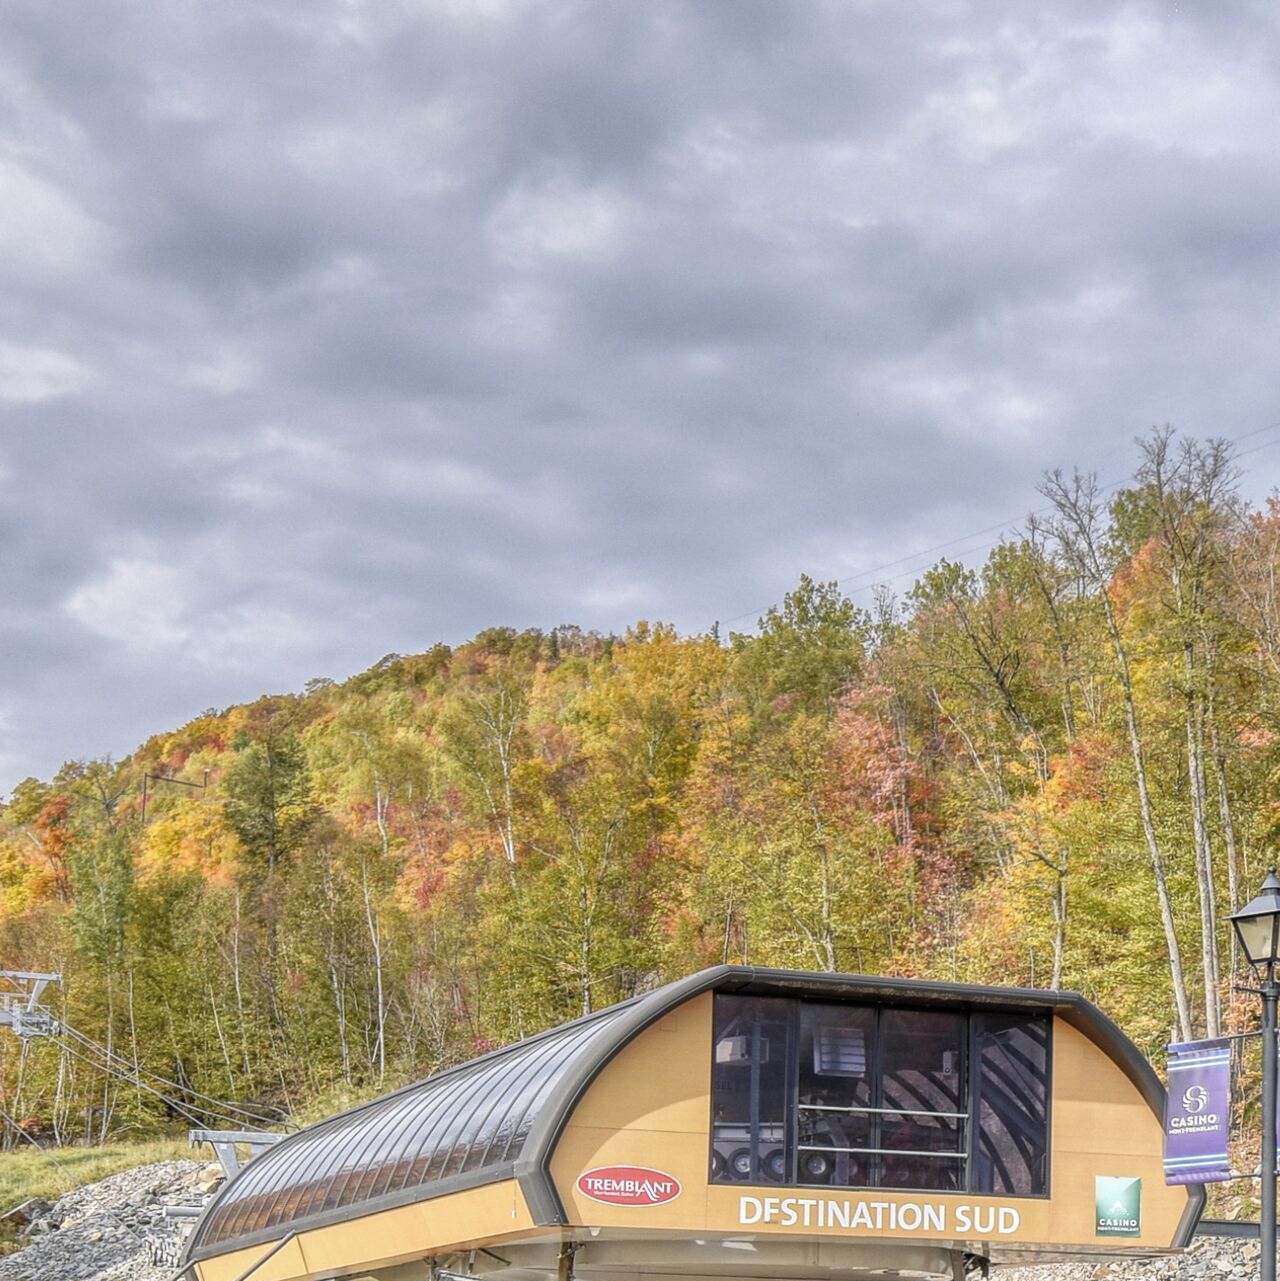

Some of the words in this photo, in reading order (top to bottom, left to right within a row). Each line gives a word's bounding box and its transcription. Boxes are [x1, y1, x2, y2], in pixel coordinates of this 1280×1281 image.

[1171, 1114, 1217, 1127] CASINO
[1169, 1125, 1219, 1134] MONT-TREMBLANT
[585, 1178, 673, 1201] TREMBLANT
[739, 1197, 945, 1231] DESTINATION
[955, 1205, 1020, 1234] SUD
[1099, 1218, 1137, 1226] CASINO
